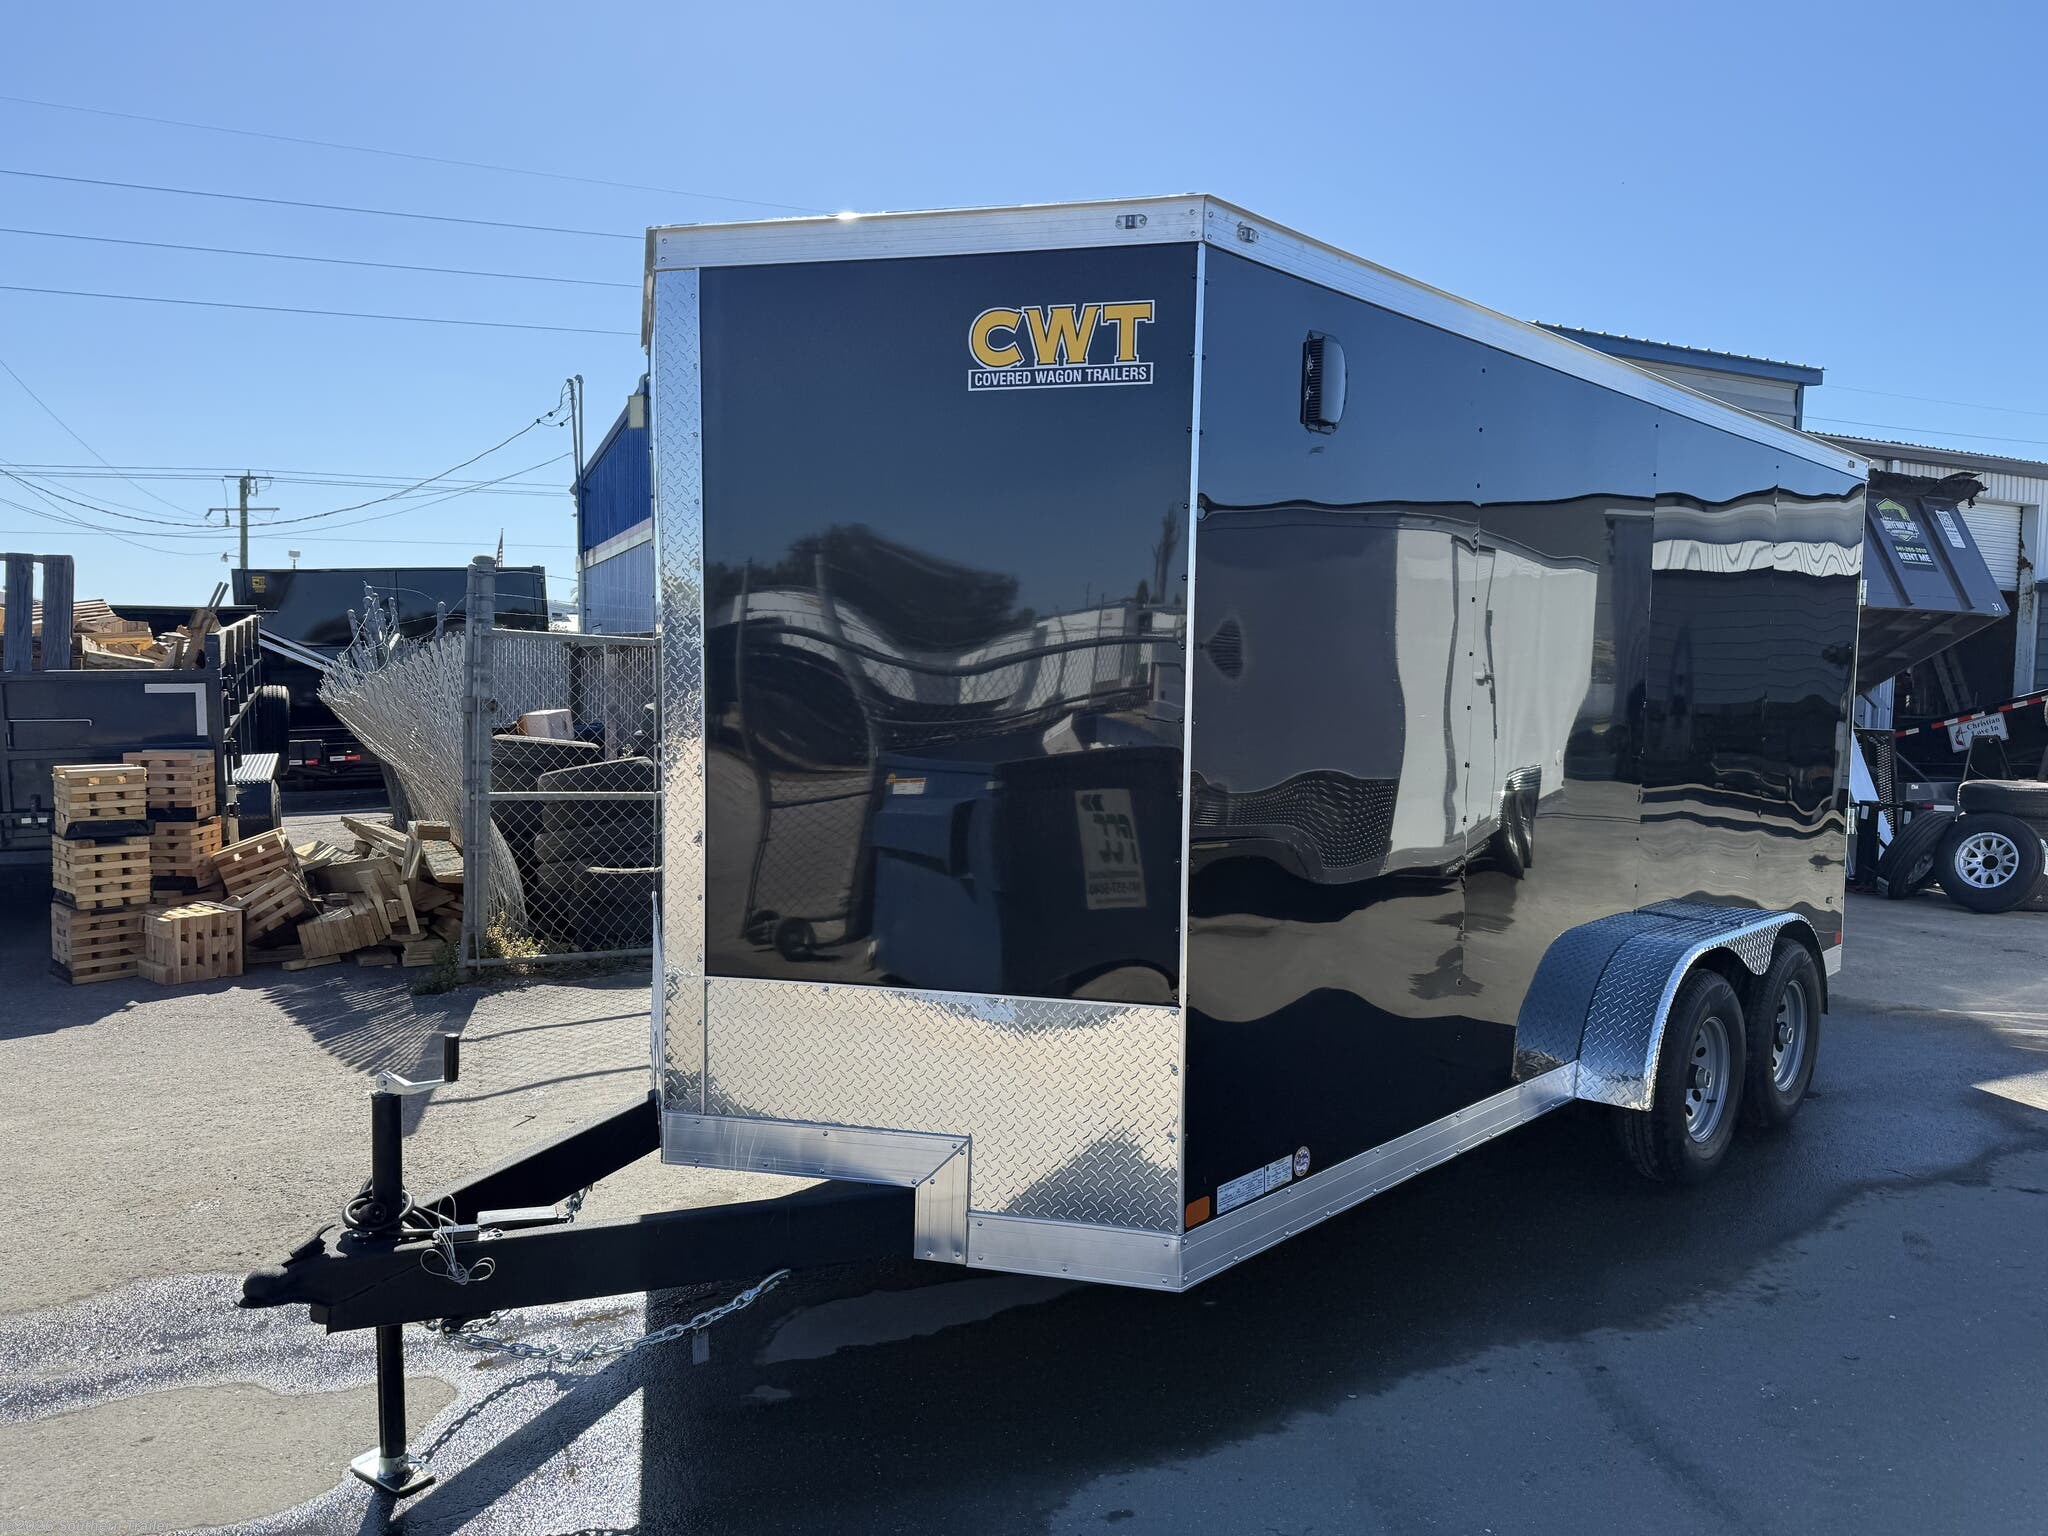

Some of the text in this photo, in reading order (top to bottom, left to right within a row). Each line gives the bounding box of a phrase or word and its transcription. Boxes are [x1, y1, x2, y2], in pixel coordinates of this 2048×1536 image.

[969, 300, 1154, 369] CWT
[975, 366, 1147, 386] COVERED WAGON TRAILERS
[1898, 552, 1932, 562] RENT ME
[1992, 603, 2001, 611] 31
[1966, 717, 2001, 730] Christian
